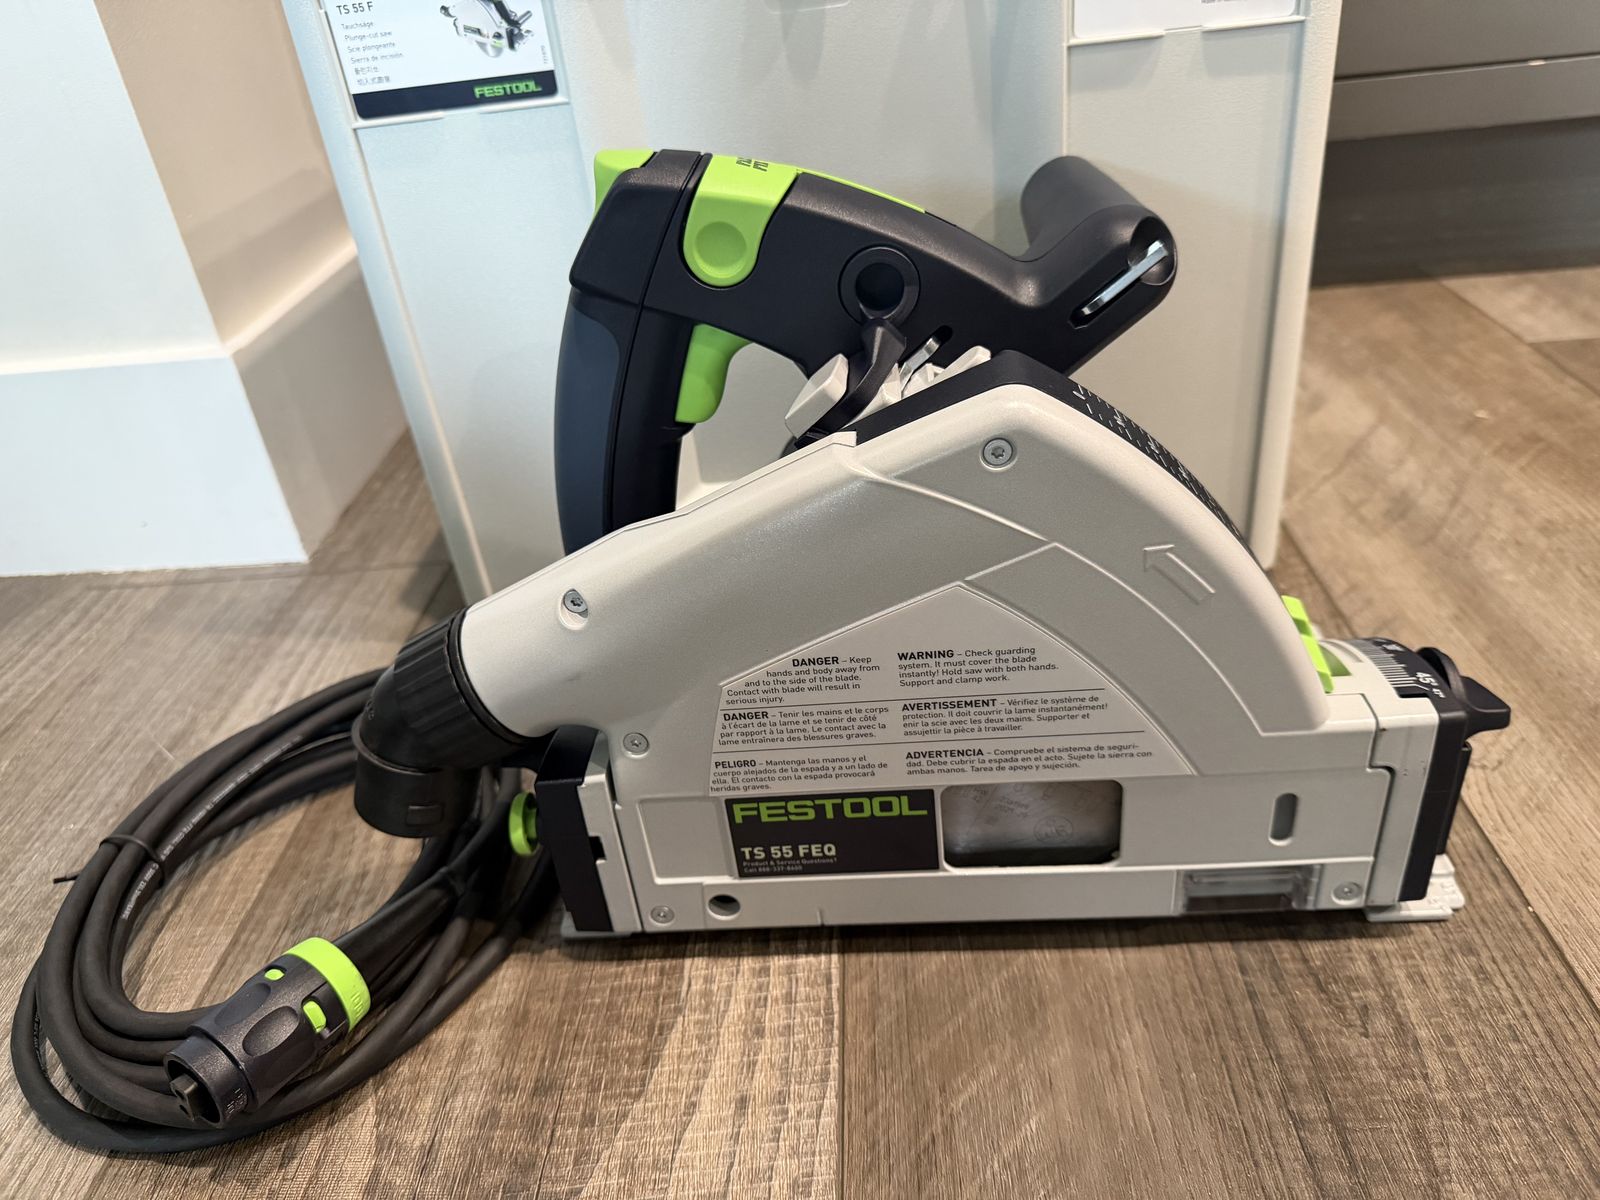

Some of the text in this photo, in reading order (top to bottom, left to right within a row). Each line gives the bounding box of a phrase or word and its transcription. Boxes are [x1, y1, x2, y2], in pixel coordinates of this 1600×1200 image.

[336, 1, 373, 15] TS 55 F
[474, 80, 542, 98] FESTOOL
[898, 646, 1036, 661] WARNING Check guarding
[792, 656, 872, 667] DANGER Keep
[898, 661, 932, 672] system.
[943, 659, 966, 667] must
[1012, 655, 1037, 663] blade
[766, 664, 880, 678] hands and body away from
[899, 669, 939, 680] instantly!
[942, 668, 962, 676] Hold
[984, 665, 1004, 673] with
[1006, 664, 1026, 672] both
[1028, 662, 1058, 671] hands.
[789, 676, 806, 684] side
[835, 673, 862, 682] blade.
[900, 678, 934, 688] Support
[955, 675, 983, 685] clamp
[985, 674, 1009, 682] work.
[727, 688, 760, 696] Contact
[761, 686, 780, 694] with
[782, 685, 805, 693] blade
[825, 682, 850, 691] result
[726, 694, 784, 705] serious injury.
[902, 699, 996, 711] AVERTISSEMENT
[1008, 698, 1038, 706] Vérifiez
[1051, 695, 1086, 706] système
[723, 711, 769, 721] DANGER
[780, 710, 799, 718] Tenir
[816, 708, 842, 716] mains
[864, 707, 889, 715] corps
[902, 711, 946, 722] protection.
[973, 708, 1002, 716] couvrir
[1014, 706, 1036, 714] lame
[1038, 702, 1108, 713] instantanément!
[1006, 714, 1034, 723] mains.
[1036, 712, 1079, 723] Supporter
[728, 721, 754, 729] l'écart
[779, 718, 800, 726] lame
[824, 716, 844, 724] tenir
[859, 714, 877, 722] côté
[736, 728, 767, 738] rapport
[786, 726, 809, 734] lame.
[824, 723, 855, 732] contact
[904, 727, 942, 738] assujettir
[953, 725, 975, 735] pièce
[984, 723, 1022, 732] travailler.
[718, 737, 739, 745] lame
[803, 732, 844, 741] blessures
[846, 732, 876, 740] graves.
[906, 748, 984, 760] ADVERTENCIA
[994, 746, 1044, 757] Compruebe
[1057, 744, 1092, 753] sistema
[715, 759, 757, 769] PELIGRO
[766, 757, 806, 768] Mantenga
[713, 770, 741, 778] cuerpo
[743, 767, 777, 777] alejados
[800, 764, 830, 774] espada
[741, 774, 776, 783] contacto
[804, 771, 833, 782] espada
[834, 769, 876, 780] provocará
[907, 767, 935, 775] ambas
[710, 784, 771, 792] heridas graves.
[733, 796, 928, 823] FESTOOL
[741, 844, 836, 860] TS 55 FEQ
